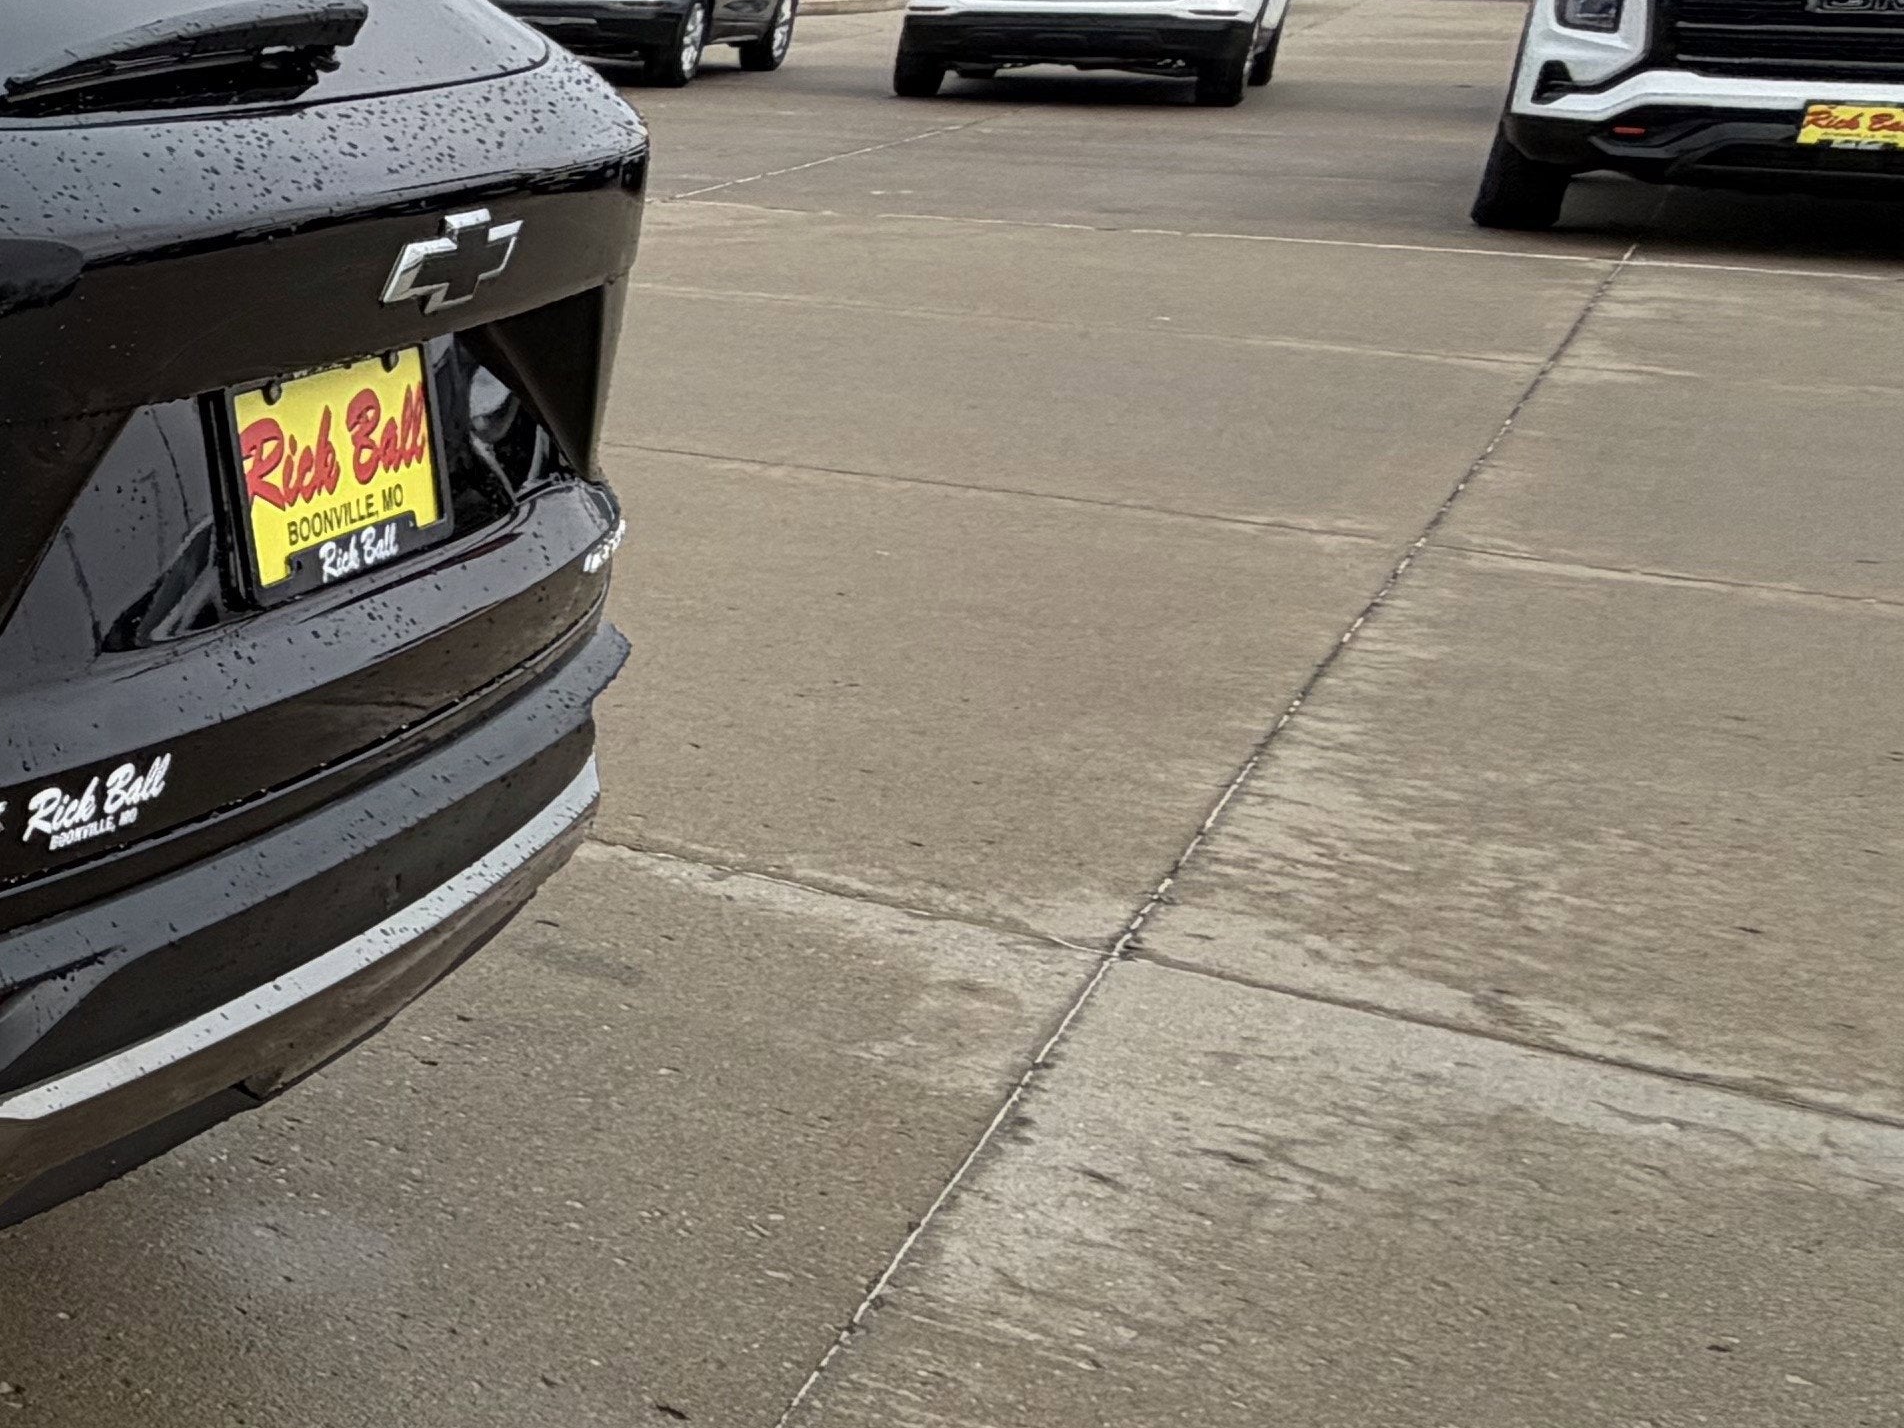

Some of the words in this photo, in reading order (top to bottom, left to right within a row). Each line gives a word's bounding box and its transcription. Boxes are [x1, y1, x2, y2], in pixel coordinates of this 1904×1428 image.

[239, 417, 341, 511] Rick
[346, 380, 428, 485] Ball
[288, 493, 380, 546] BOONVILLE,
[381, 483, 404, 513] MO
[318, 533, 360, 583] Rick
[360, 523, 399, 565] Ball
[22, 776, 100, 842] Rick
[103, 753, 172, 815] Ball
